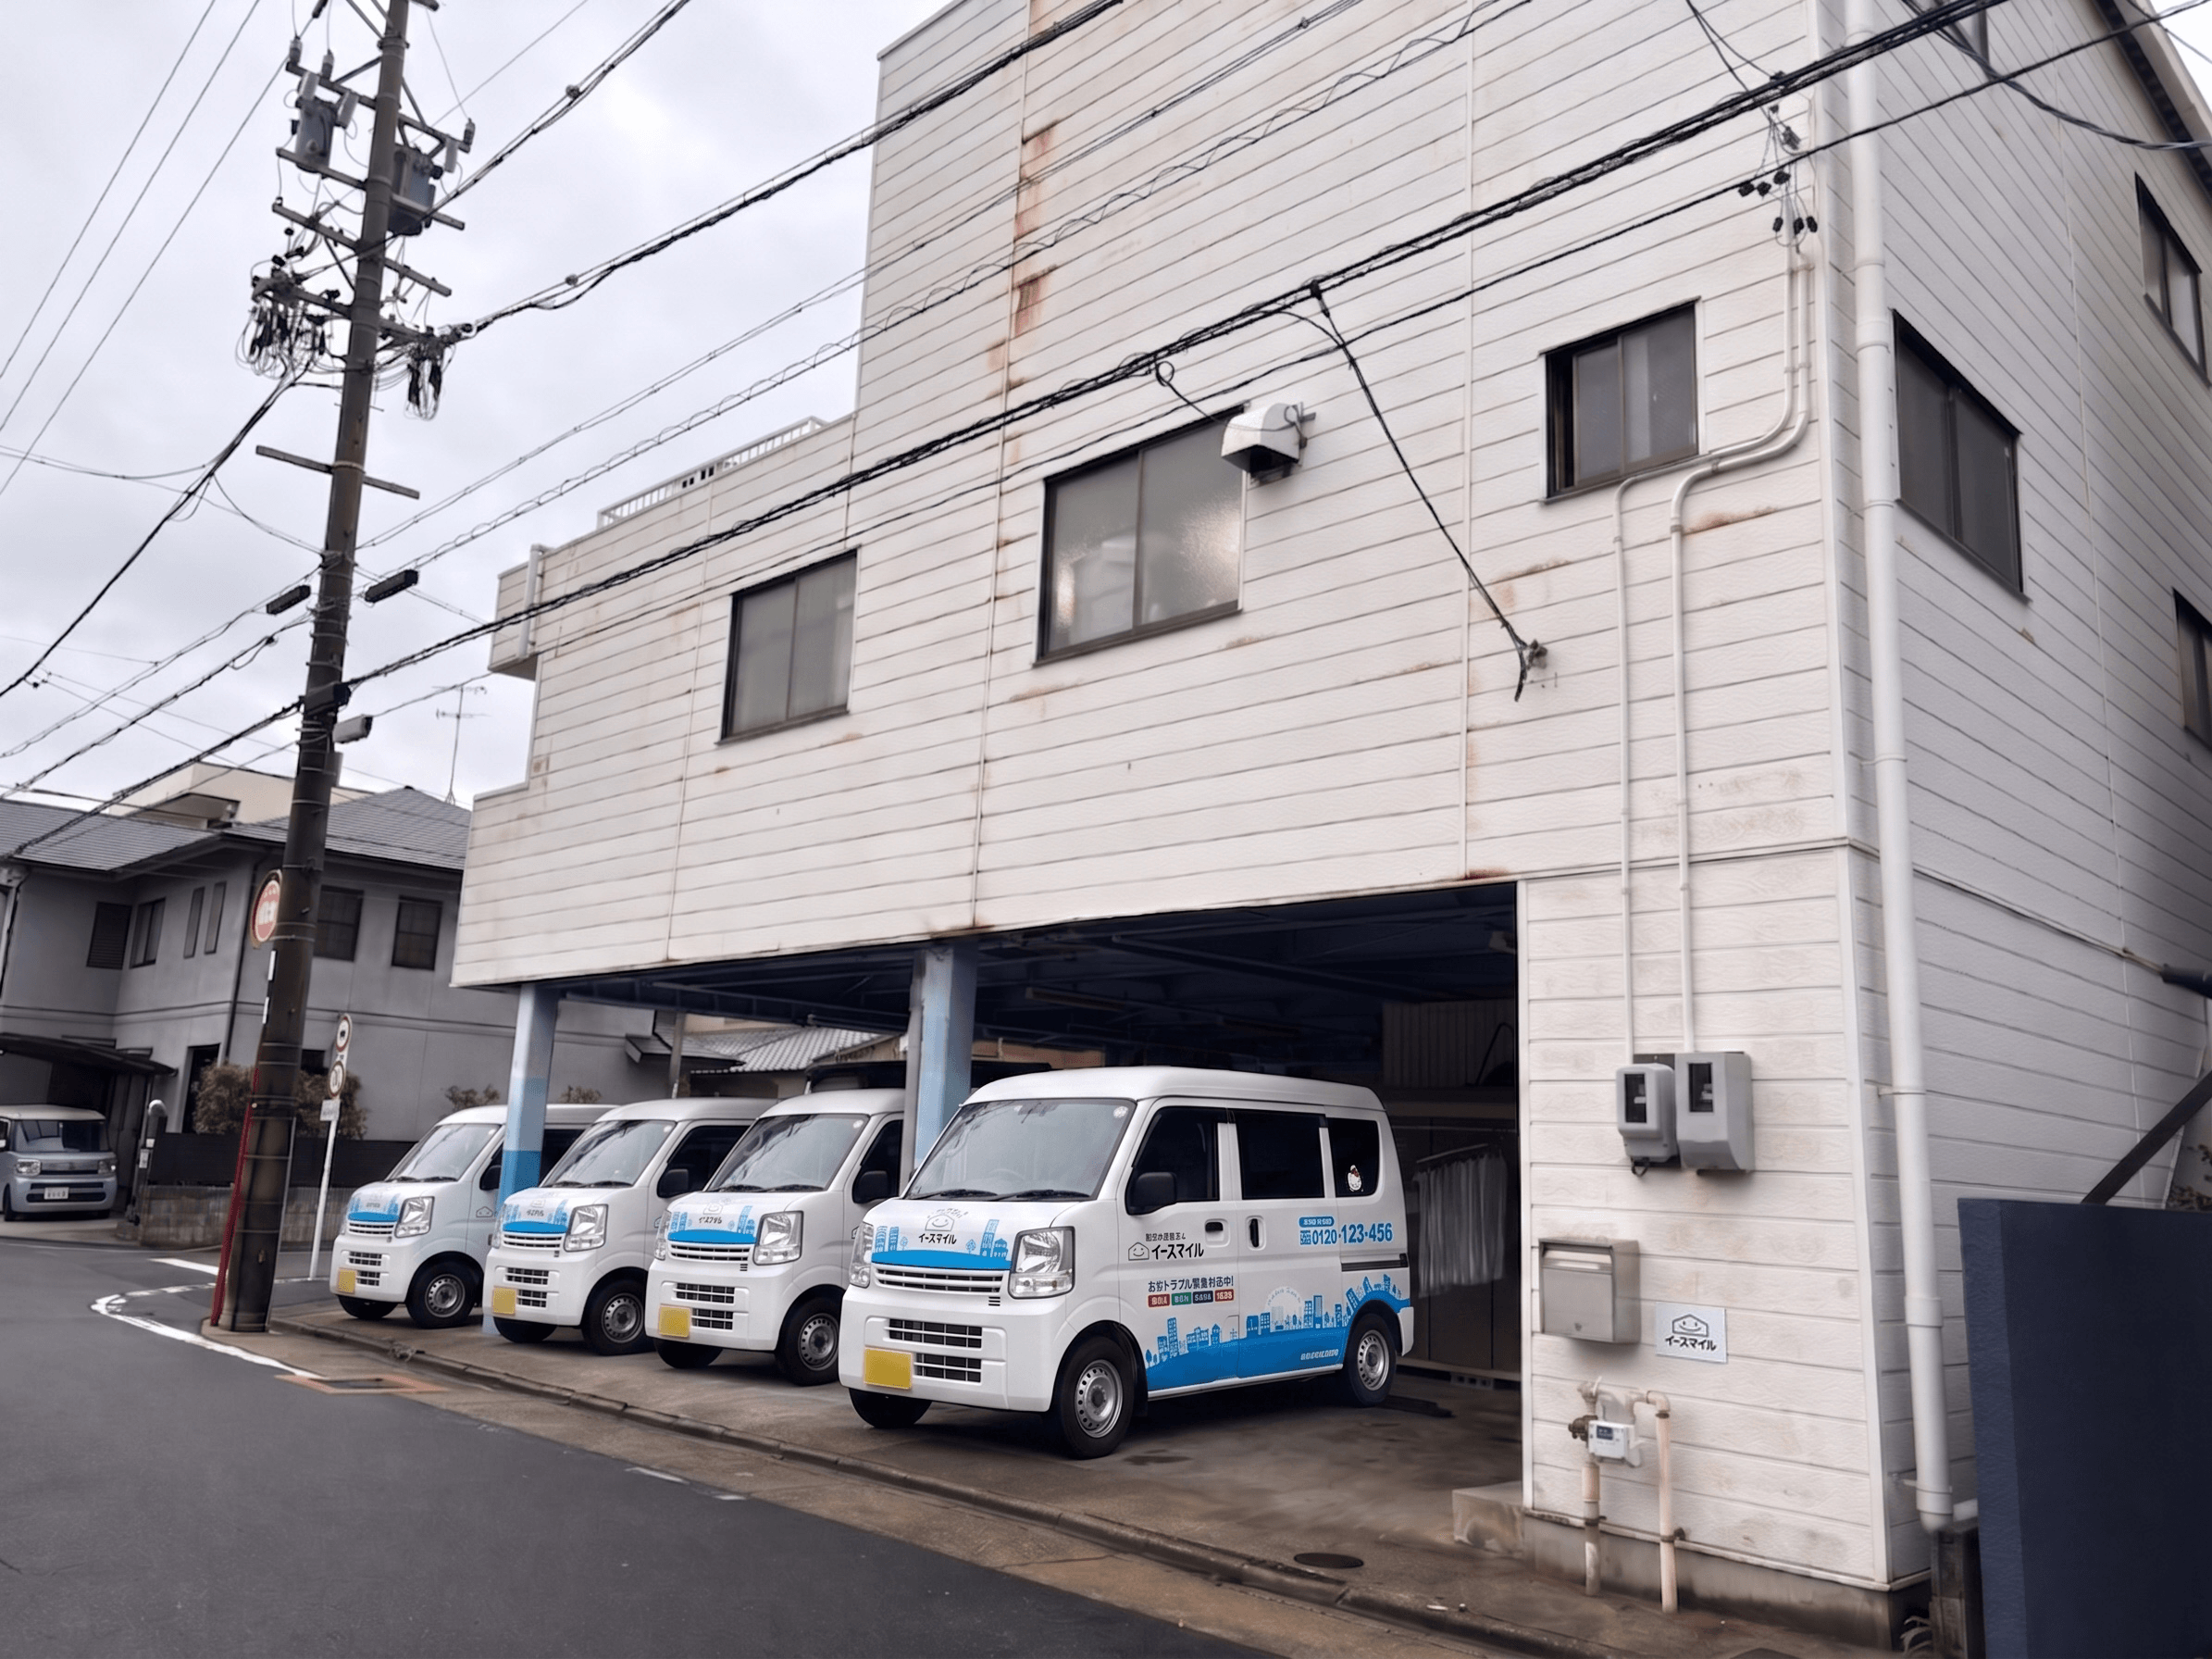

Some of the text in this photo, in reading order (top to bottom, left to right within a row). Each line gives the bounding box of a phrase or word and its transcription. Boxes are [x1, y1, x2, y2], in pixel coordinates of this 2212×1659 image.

[1151, 1242, 1204, 1260] イースマイル
[1665, 1336, 1716, 1351] イースマイル
